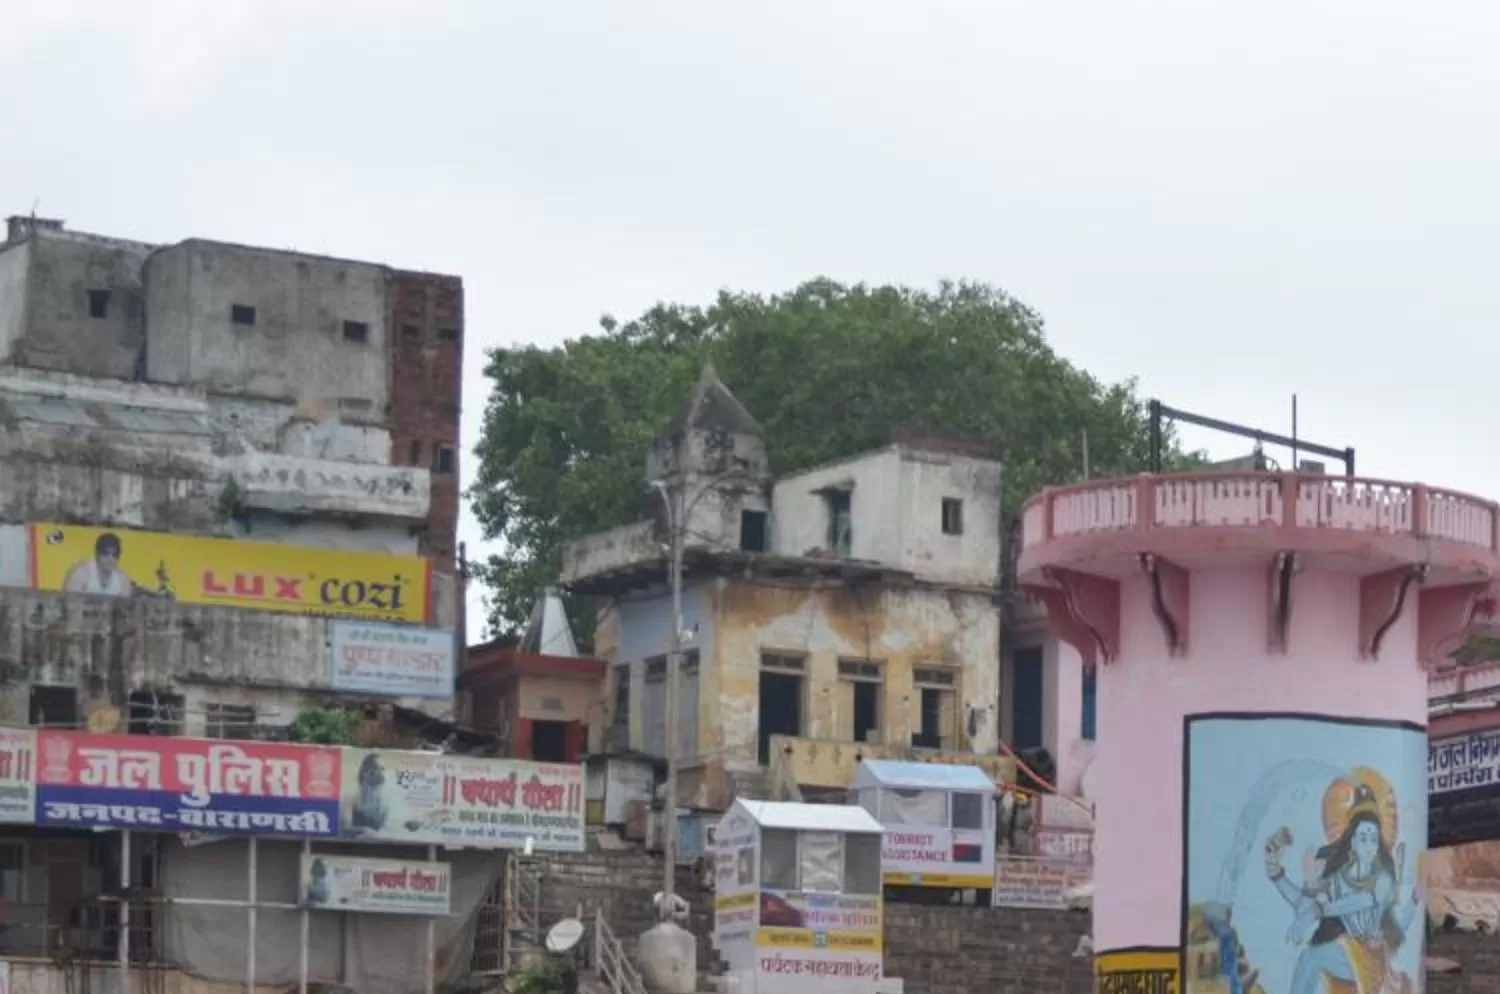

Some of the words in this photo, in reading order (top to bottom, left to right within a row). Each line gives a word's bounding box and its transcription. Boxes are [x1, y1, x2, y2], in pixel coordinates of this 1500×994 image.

[319, 573, 404, 609] cozi
[77, 745, 162, 791] जल
[175, 743, 301, 807] पुलिस
